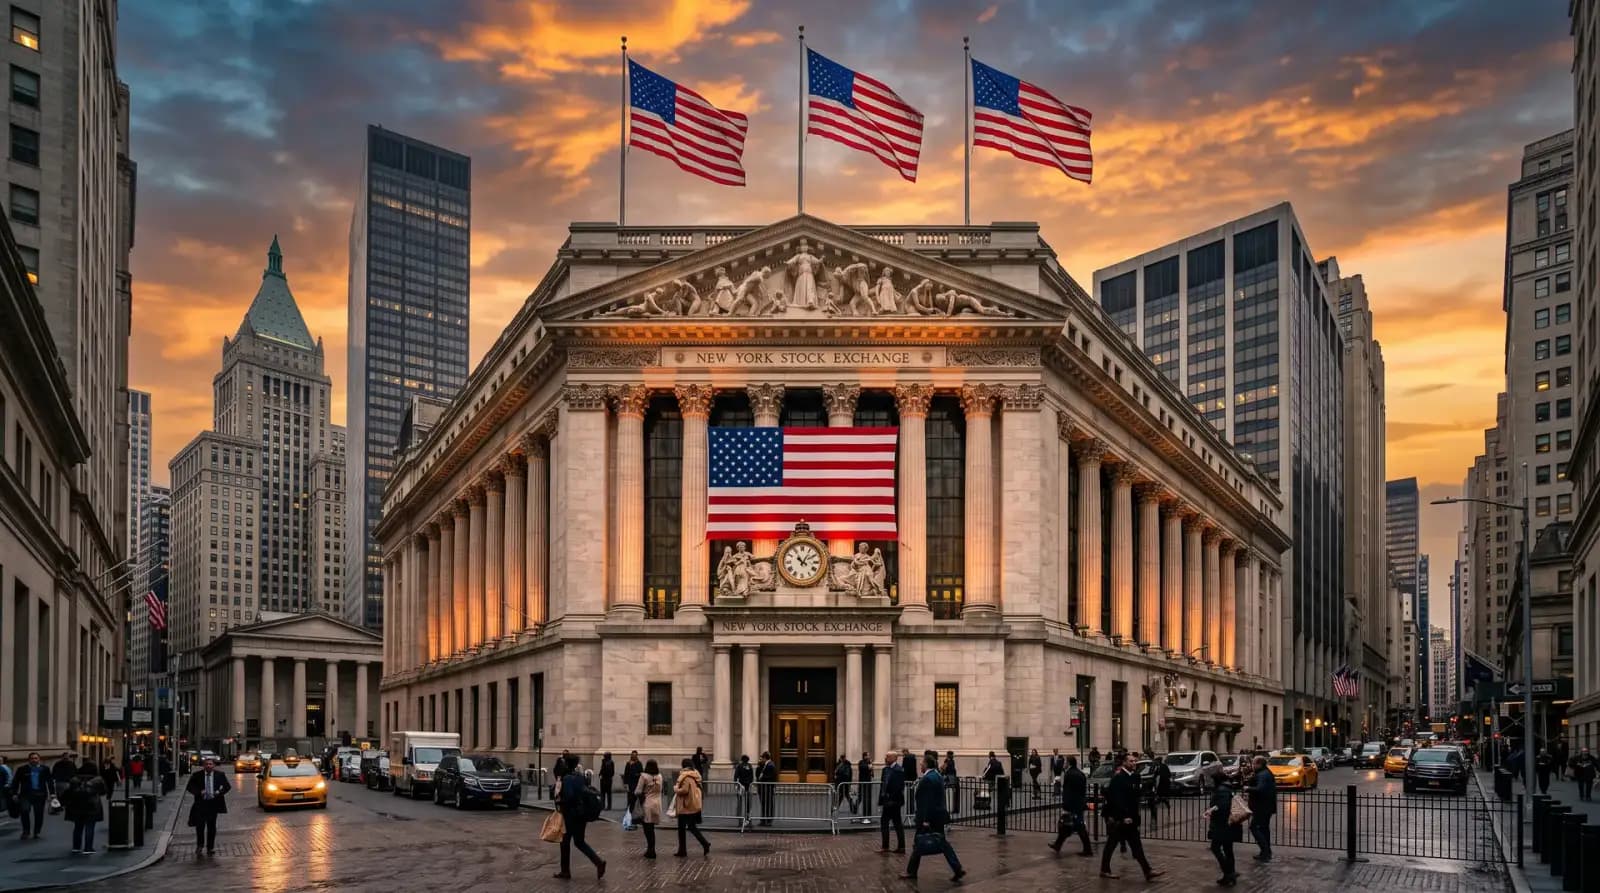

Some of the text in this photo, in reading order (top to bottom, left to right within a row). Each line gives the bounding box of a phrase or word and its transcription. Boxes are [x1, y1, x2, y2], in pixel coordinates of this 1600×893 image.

[697, 352, 910, 364] NEW YORK STOCK EXCHANGE
[722, 622, 883, 632] NEW YORK STOCK EXCHANGE
